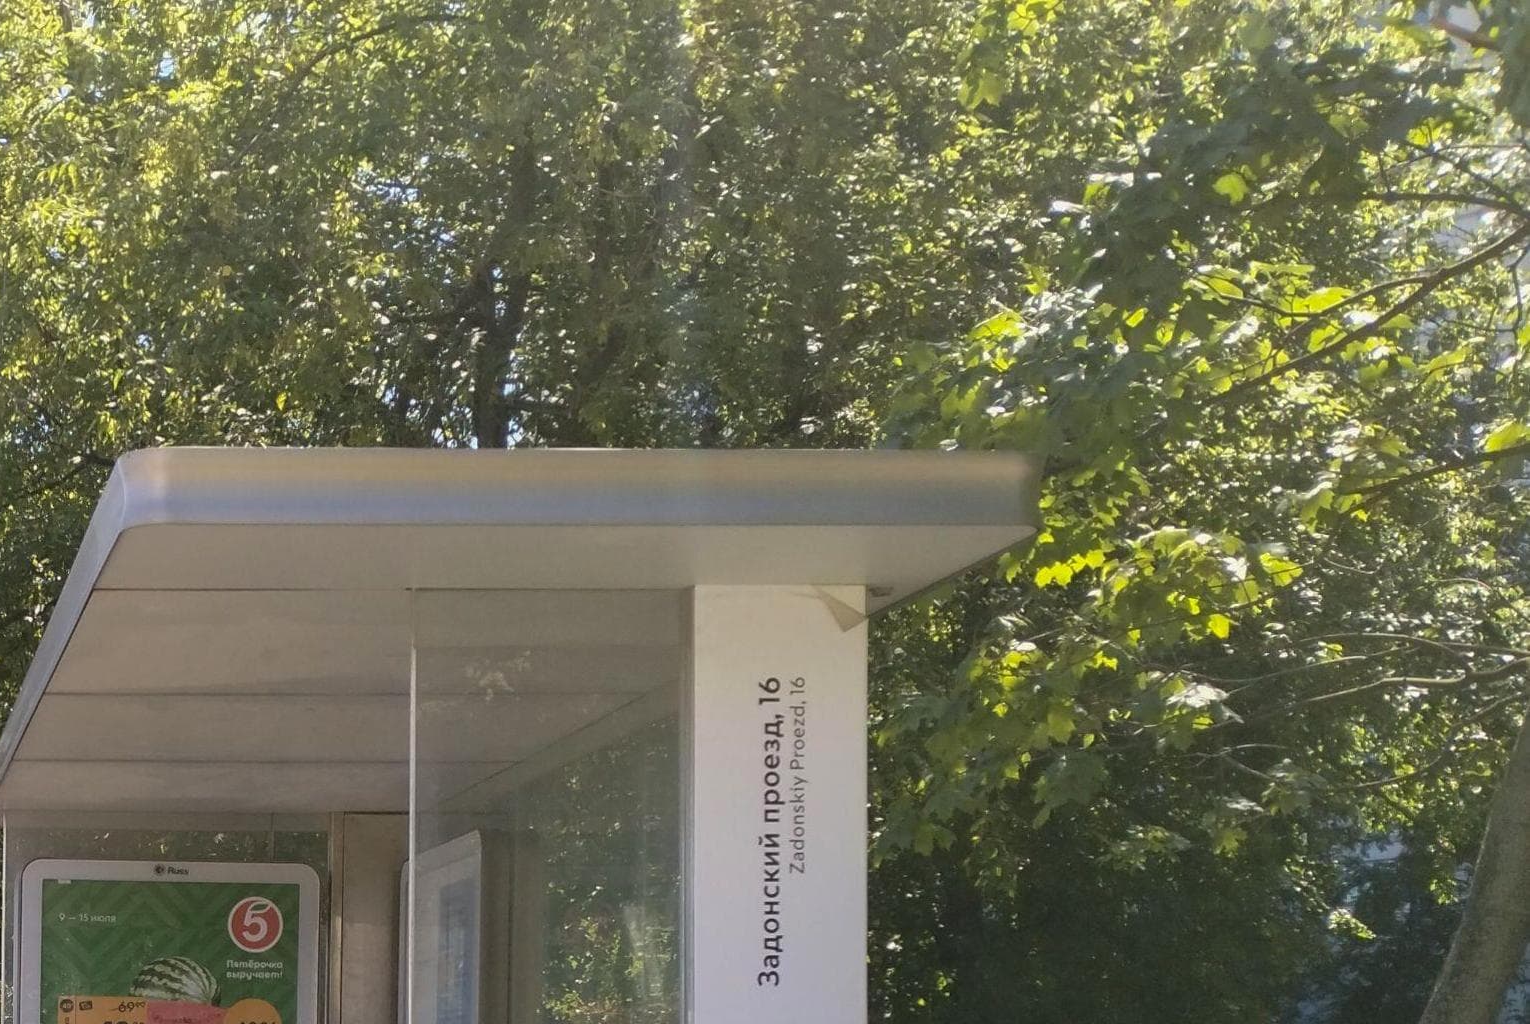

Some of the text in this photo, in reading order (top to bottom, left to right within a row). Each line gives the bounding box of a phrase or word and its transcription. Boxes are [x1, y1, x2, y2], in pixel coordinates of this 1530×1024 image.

[757, 677, 785, 987] Задонский проезд, 16
[789, 676, 808, 874] Zadonskiy Proezd, 16
[58, 912, 65, 922] 9
[79, 912, 89, 922] 15
